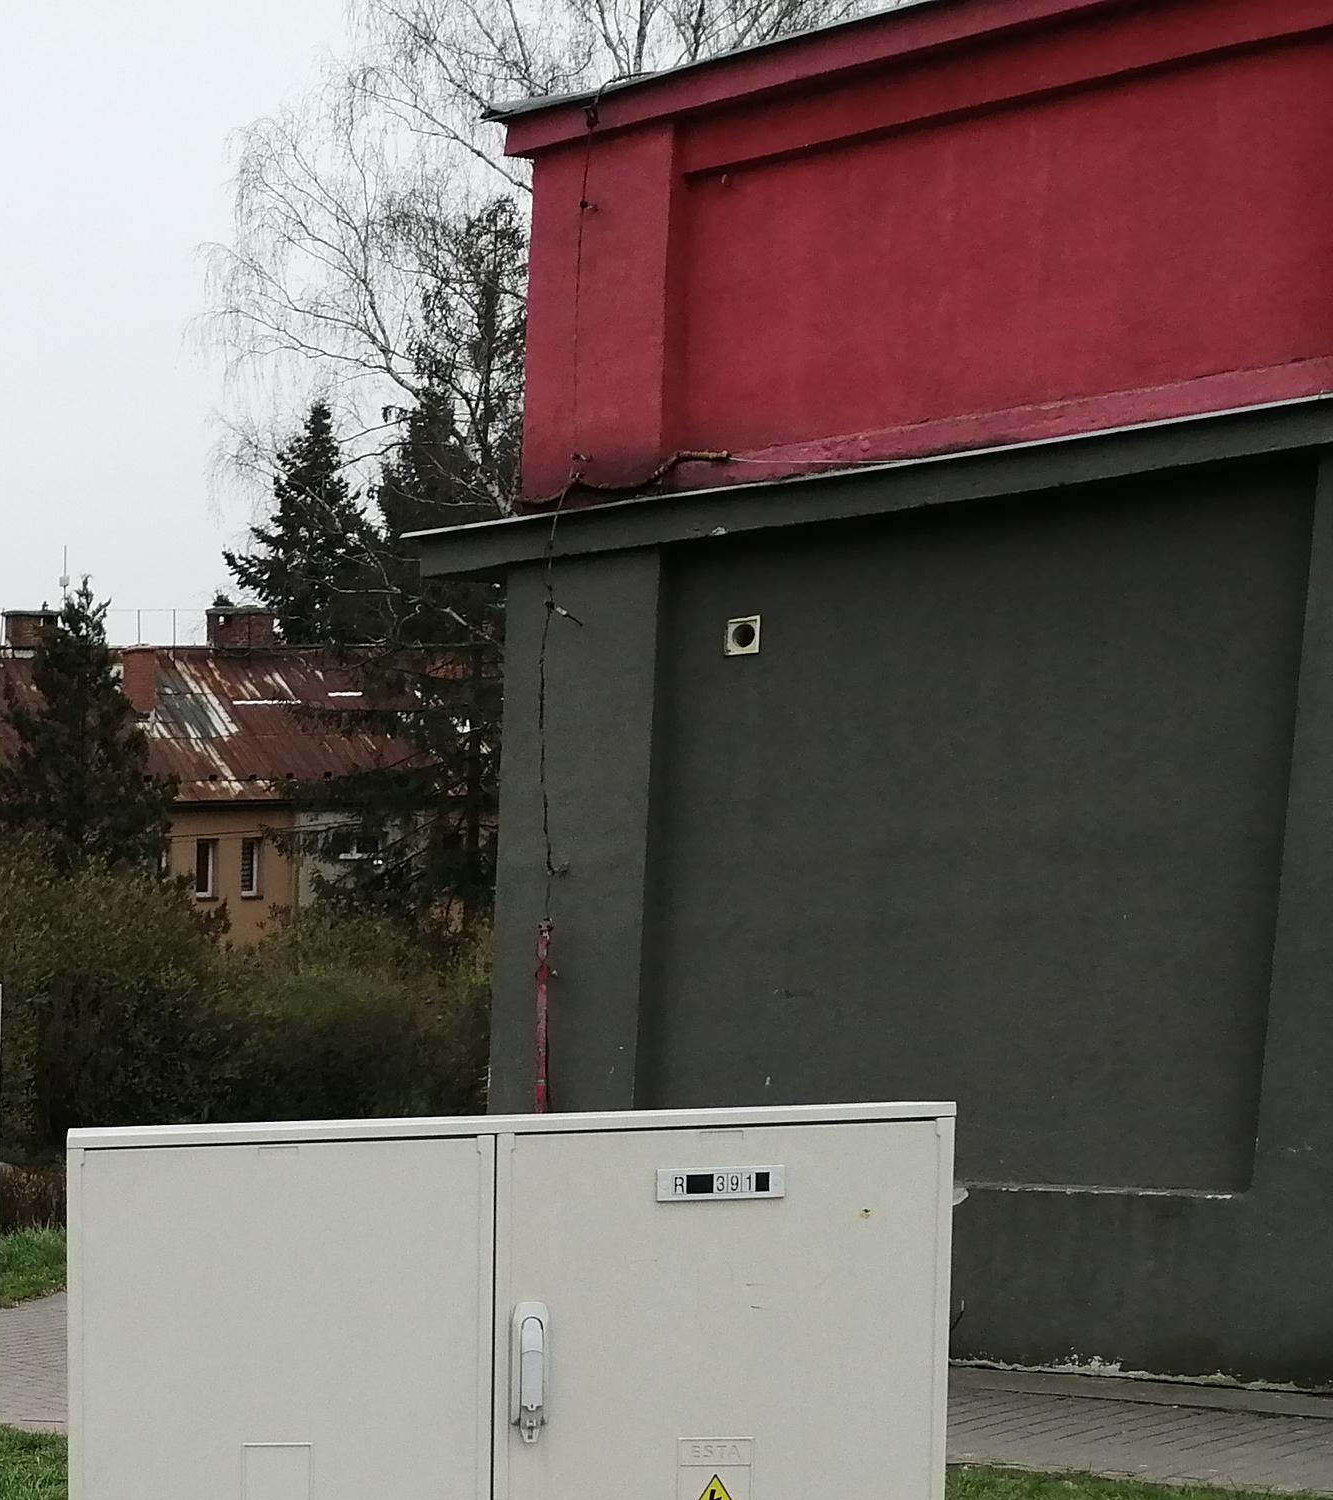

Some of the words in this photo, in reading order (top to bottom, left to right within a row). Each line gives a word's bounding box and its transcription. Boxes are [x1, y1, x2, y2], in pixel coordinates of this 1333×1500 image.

[674, 1176, 685, 1193] R
[716, 1174, 752, 1192] 391
[692, 1444, 741, 1458] ESTA
